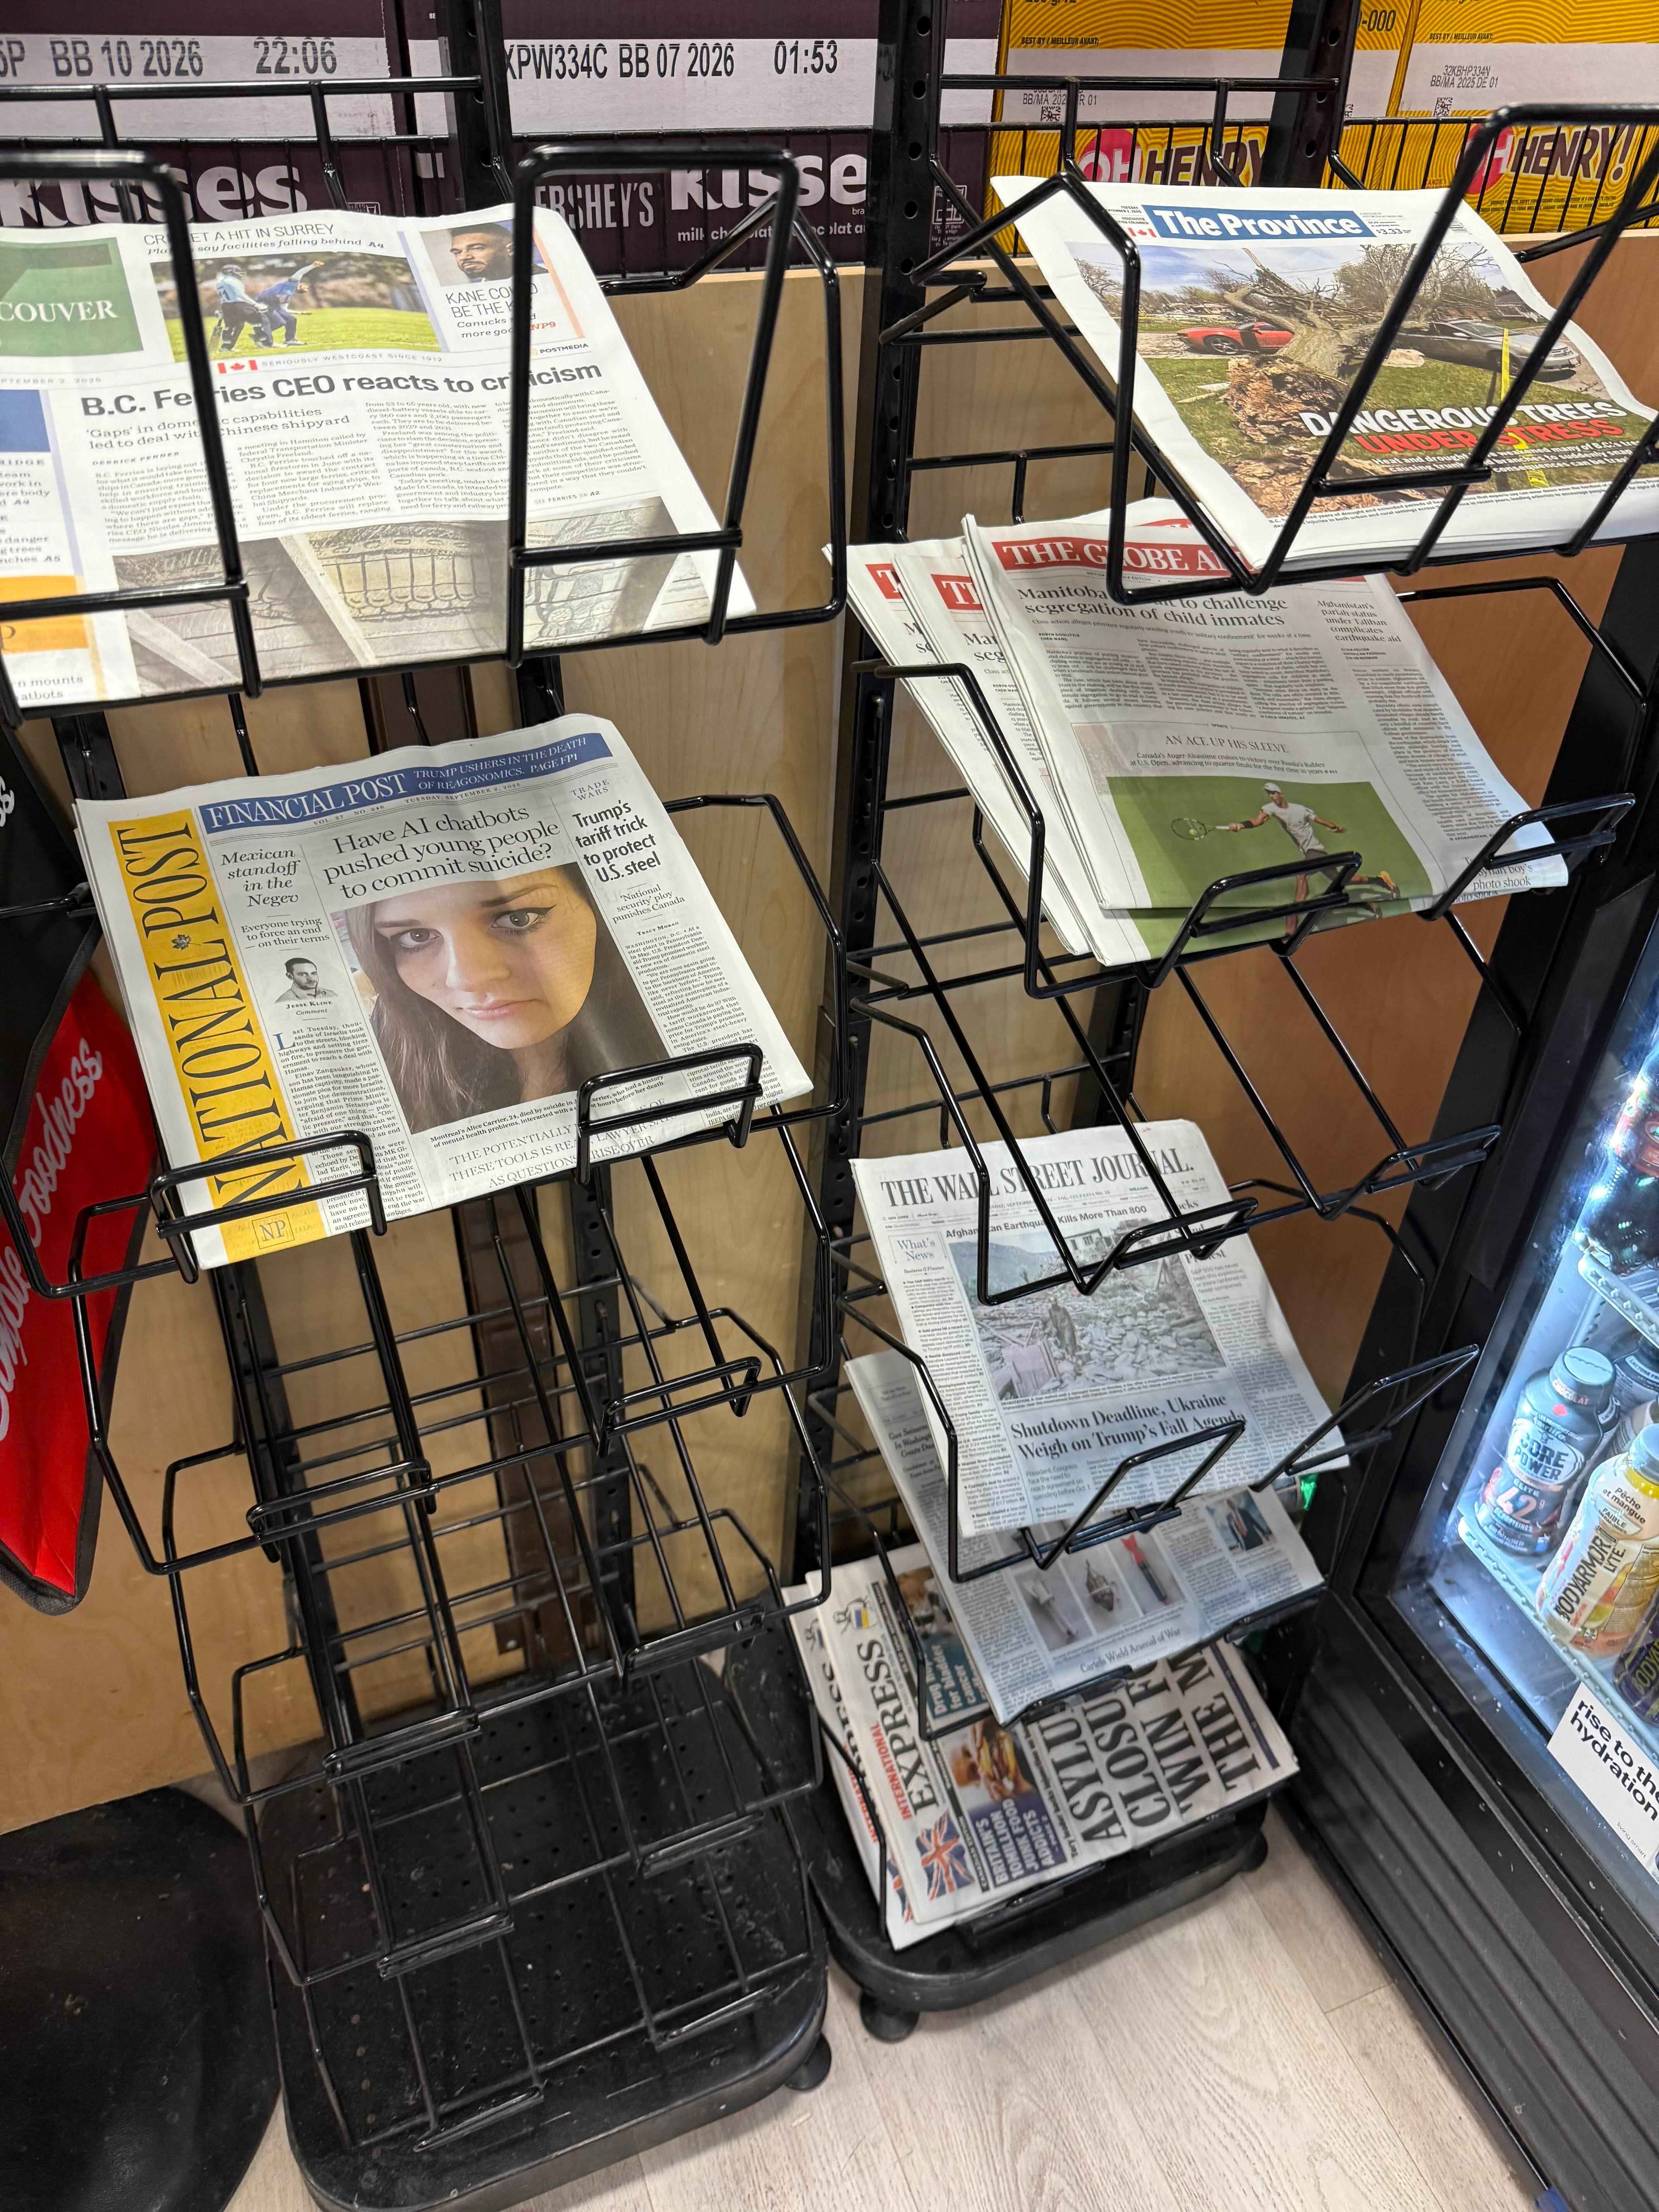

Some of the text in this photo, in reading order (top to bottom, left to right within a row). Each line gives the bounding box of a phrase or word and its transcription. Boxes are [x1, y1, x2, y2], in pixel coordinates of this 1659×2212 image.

[50, 36, 337, 77] BB 10 2026 22:06
[619, 43, 649, 78] BB
[657, 43, 680, 77] 07
[686, 42, 735, 77] 2026
[773, 40, 838, 76] 01:53
[1430, 76, 1498, 88] BB/MA 2025 DE 01
[1, 163, 307, 227] kisses
[144, 223, 334, 246] CRET A HIT IN SURREY
[1152, 210, 1363, 236] The Province
[445, 290, 487, 304] KANE
[451, 302, 503, 318] BE THE
[540, 343, 589, 354] POSTMEDIA
[81, 362, 603, 417] B.C. Feies CEO reacts to cricism
[1516, 401, 1627, 423] TREES
[1003, 542, 1189, 570] THE GOBE
[1017, 586, 1108, 601] Manitoba
[1202, 596, 1288, 611] challenge
[1024, 601, 1285, 627] segregation of child inmates
[413, 737, 588, 779] TRUMP USHERS IN THE DEATH
[1166, 735, 1289, 753] AN ACE UP HIS SLEEVE
[419, 780, 435, 790] OF
[436, 767, 526, 790] REAGONOMICS.
[530, 758, 559, 773] PAGE
[570, 779, 610, 796] TRADE
[205, 773, 408, 829] FINANCIAL POST
[577, 786, 610, 802] WARS
[332, 805, 530, 854] Have AI chatbots
[572, 799, 632, 829] Trump's
[575, 815, 648, 851] tariff trick
[220, 847, 296, 866] Mexican
[323, 821, 561, 885] pushed young people
[583, 833, 657, 867] to protect
[228, 859, 301, 880] standoff
[340, 841, 552, 900] to commit suicide?
[596, 850, 662, 883] U.S. steel
[243, 877, 294, 893] in the
[247, 892, 299, 908] Negev
[612, 897, 686, 924] punishes Canada
[117, 821, 304, 1209] NATIONAL POST
[296, 1007, 328, 1016] Comment
[448, 1125, 572, 1165] 'THE POTENTIALLY
[449, 1146, 554, 1182] THESE TOOLS IS
[488, 1175, 505, 1188] AS
[619, 1135, 656, 1153] OVER
[881, 1177, 934, 1207] THE
[1057, 1204, 1147, 1224] Kills More Than 800
[259, 1220, 287, 1242] NP
[896, 1237, 936, 1251] What's
[905, 1249, 935, 1262] News
[1010, 1394, 1227, 1440] Shutdown Deadline, Ukraine
[1018, 1439, 1069, 1460] Weigh
[1072, 1437, 1092, 1451] on
[1091, 1424, 1158, 1449] Trump's
[1161, 1418, 1188, 1437] Fall
[1519, 1432, 1569, 1469] CORE
[1514, 1447, 1563, 1481] POWER
[1611, 1495, 1646, 1525] mangue
[1615, 1487, 1641, 1510] Pêche
[1602, 1508, 1627, 1528] FAIBLE
[1553, 1535, 1612, 1623] BODYARMOR
[857, 1638, 941, 1815] EXPRESS
[1577, 1699, 1633, 1767] rise to
[1191, 1692, 1261, 1793] THE
[871, 1723, 914, 1820] INTERNATIONAL
[1570, 1711, 1658, 1821] hydration
[1002, 1798, 1039, 1871] JUNK FOOD
[1022, 1809, 1056, 1866] ADDICTS
